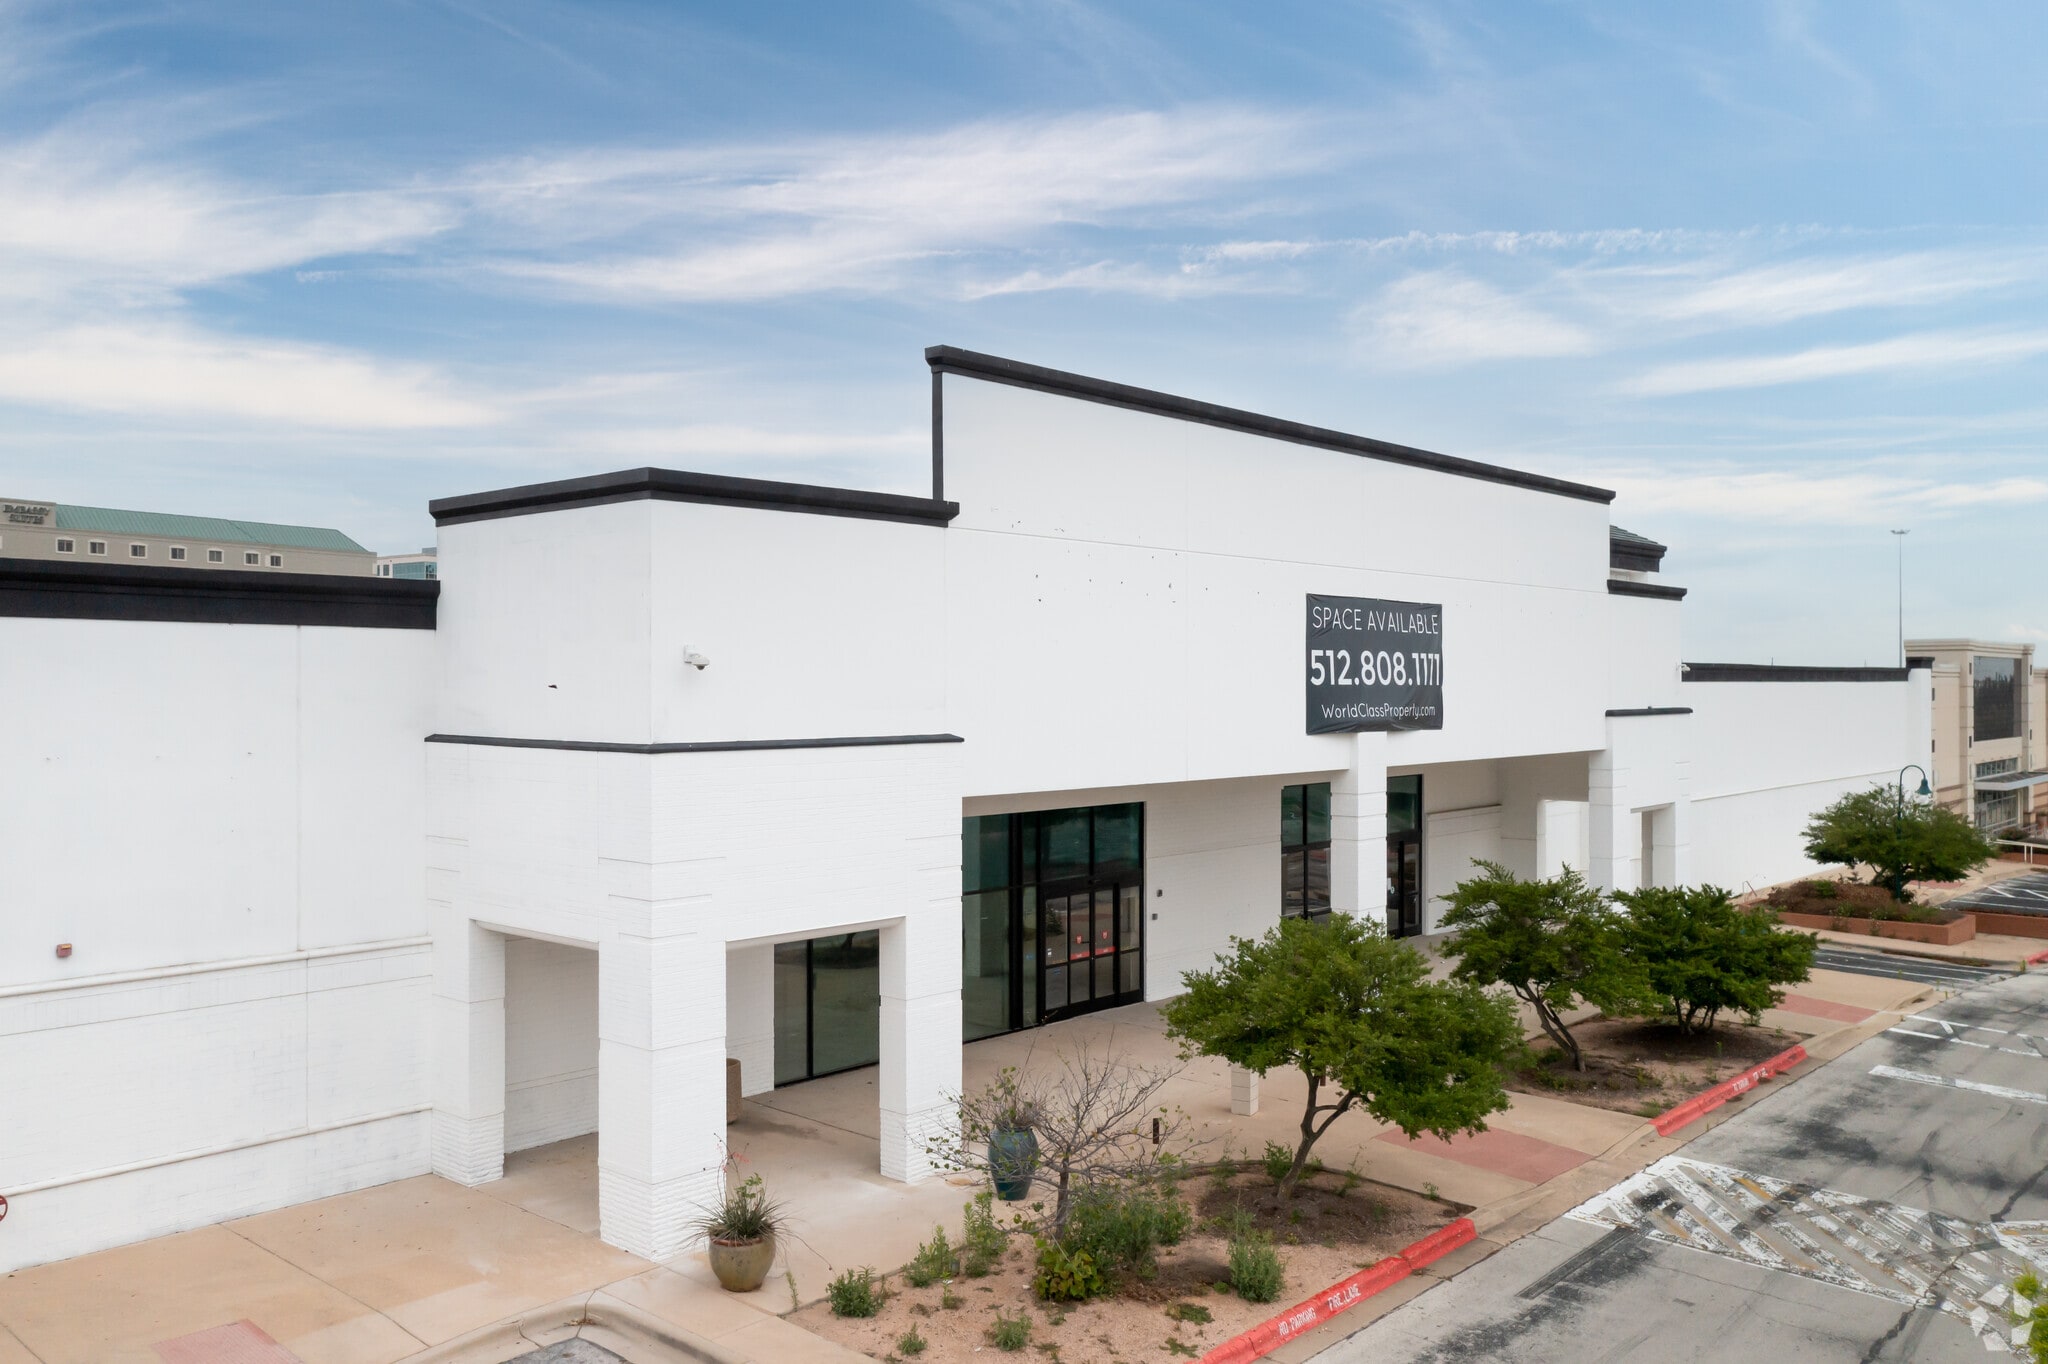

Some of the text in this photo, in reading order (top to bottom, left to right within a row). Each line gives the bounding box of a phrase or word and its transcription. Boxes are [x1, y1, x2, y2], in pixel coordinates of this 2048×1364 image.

[1312, 606, 1439, 635] SPACE AVAILABLE
[1310, 649, 1440, 686] 512.808.1111
[1321, 702, 1436, 720] WorldClassProperty.com
[1278, 1320, 1290, 1336] NO
[1289, 1307, 1317, 1331] PARKING
